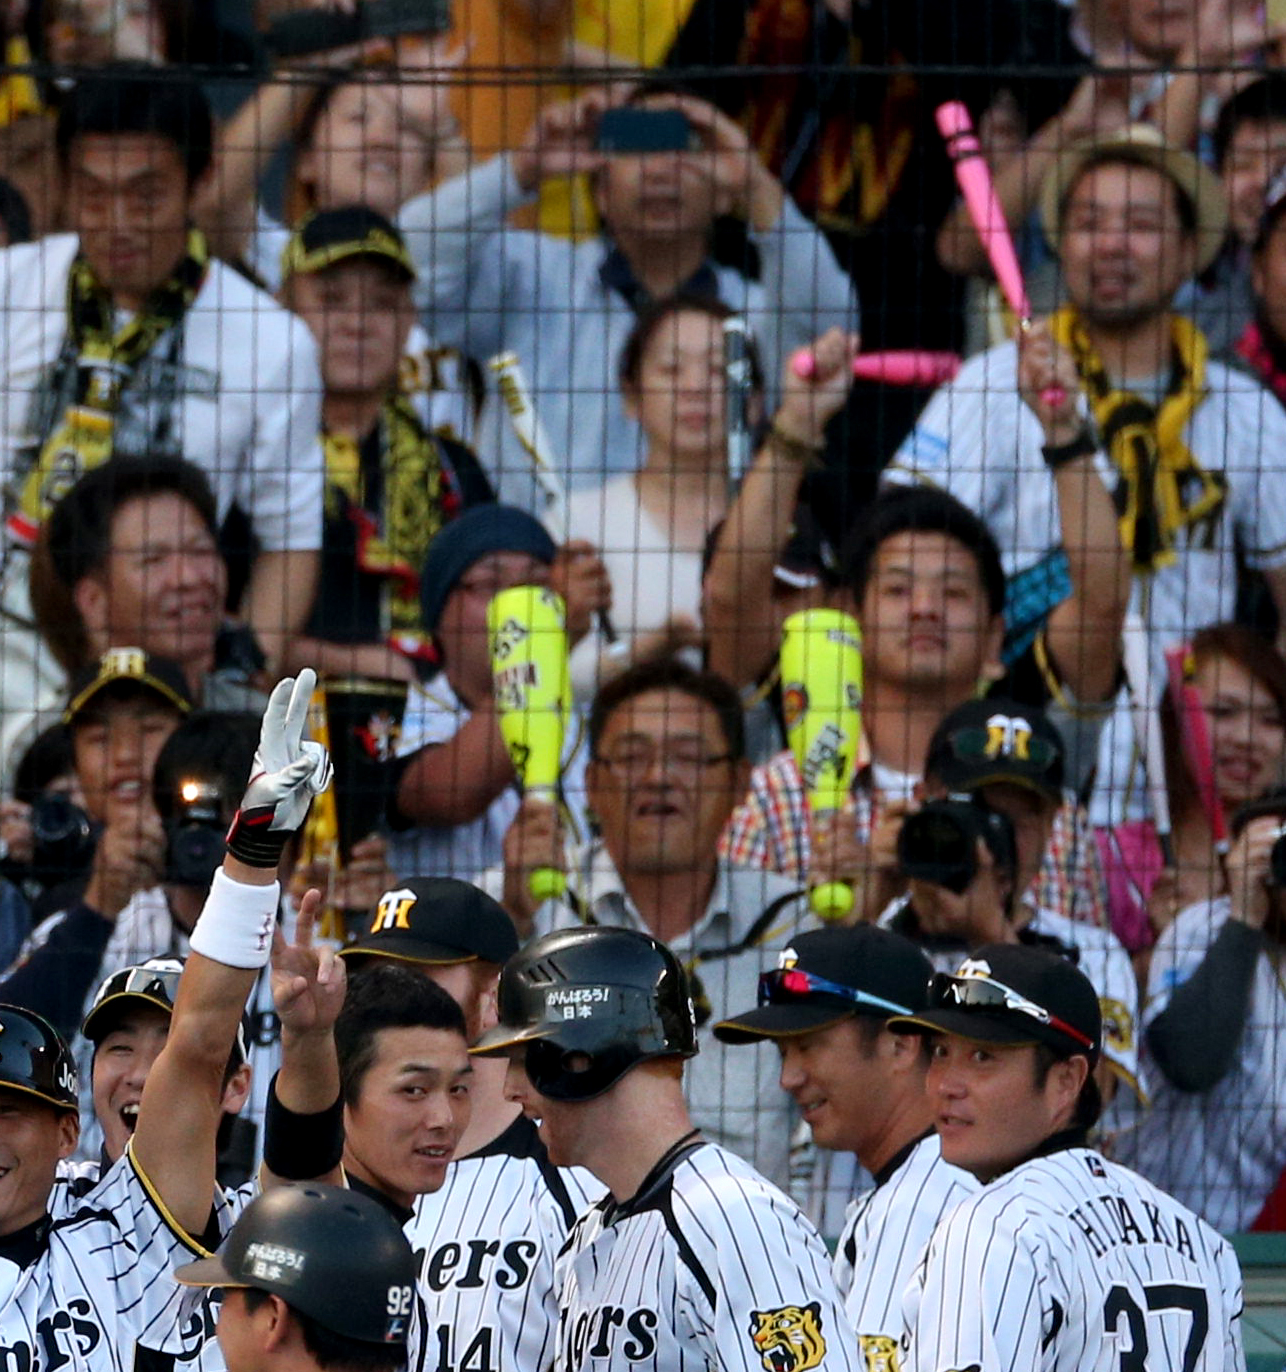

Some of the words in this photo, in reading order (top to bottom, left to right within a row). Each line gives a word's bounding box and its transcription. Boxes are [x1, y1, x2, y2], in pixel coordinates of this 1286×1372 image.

[563, 1005, 592, 1020] 日本
[427, 1239, 537, 1292] ers
[386, 1285, 412, 1316] 92
